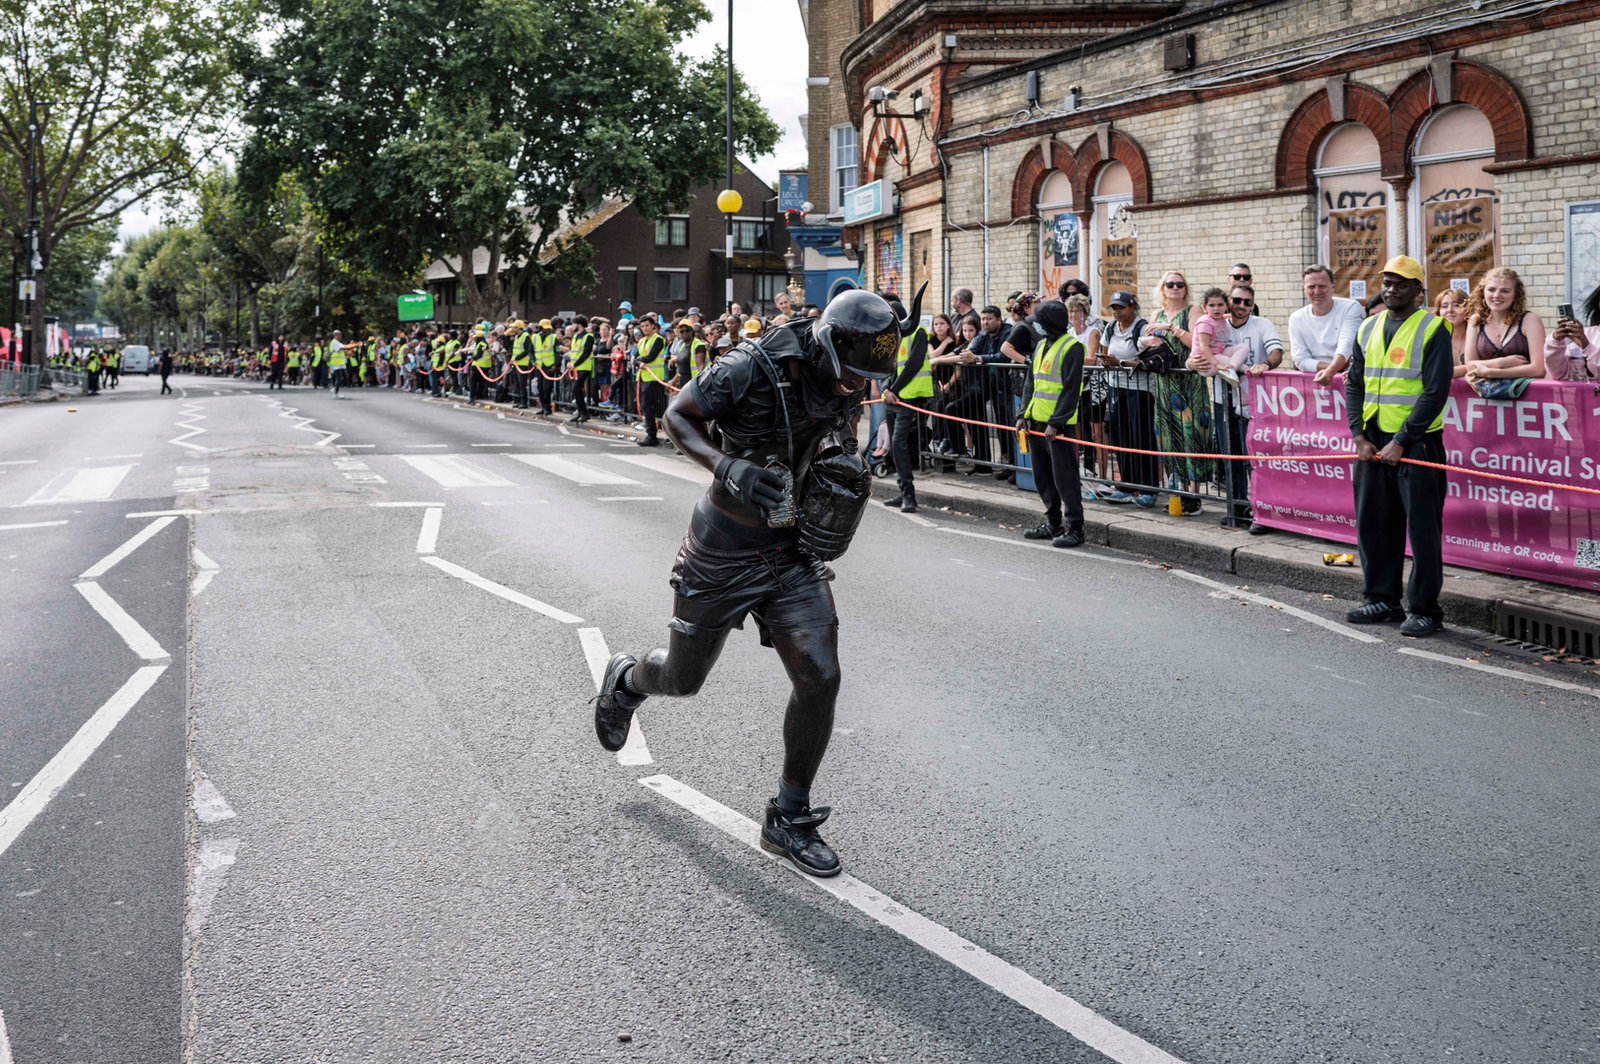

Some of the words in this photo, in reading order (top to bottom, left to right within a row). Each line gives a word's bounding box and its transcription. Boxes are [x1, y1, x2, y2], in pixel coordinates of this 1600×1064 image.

[1336, 216, 1378, 232] NHC
[1434, 206, 1482, 227] NHC
[1430, 234, 1448, 244] WE
[1452, 232, 1488, 242] KNOW
[1106, 244, 1133, 256] NHC
[1336, 247, 1379, 257] GETTING
[1454, 244, 1488, 254] BRIGHT
[1338, 258, 1378, 267] STARTED
[1256, 384, 1305, 417] NO
[1442, 396, 1574, 442] AFTER
[1253, 426, 1272, 442] at
[1276, 426, 1357, 452] Westbou
[1470, 446, 1572, 478] Carnival
[1256, 452, 1310, 474] Please
[1314, 463, 1344, 480] use
[1467, 479, 1560, 512] instead.
[1256, 500, 1273, 511] Plan
[1274, 504, 1292, 514] your
[1292, 506, 1324, 522] journey
[1326, 514, 1336, 522] at
[1445, 534, 1490, 552] scanning
[1492, 542, 1511, 554] the
[1513, 545, 1530, 558] QR
[1533, 550, 1564, 564] code.
